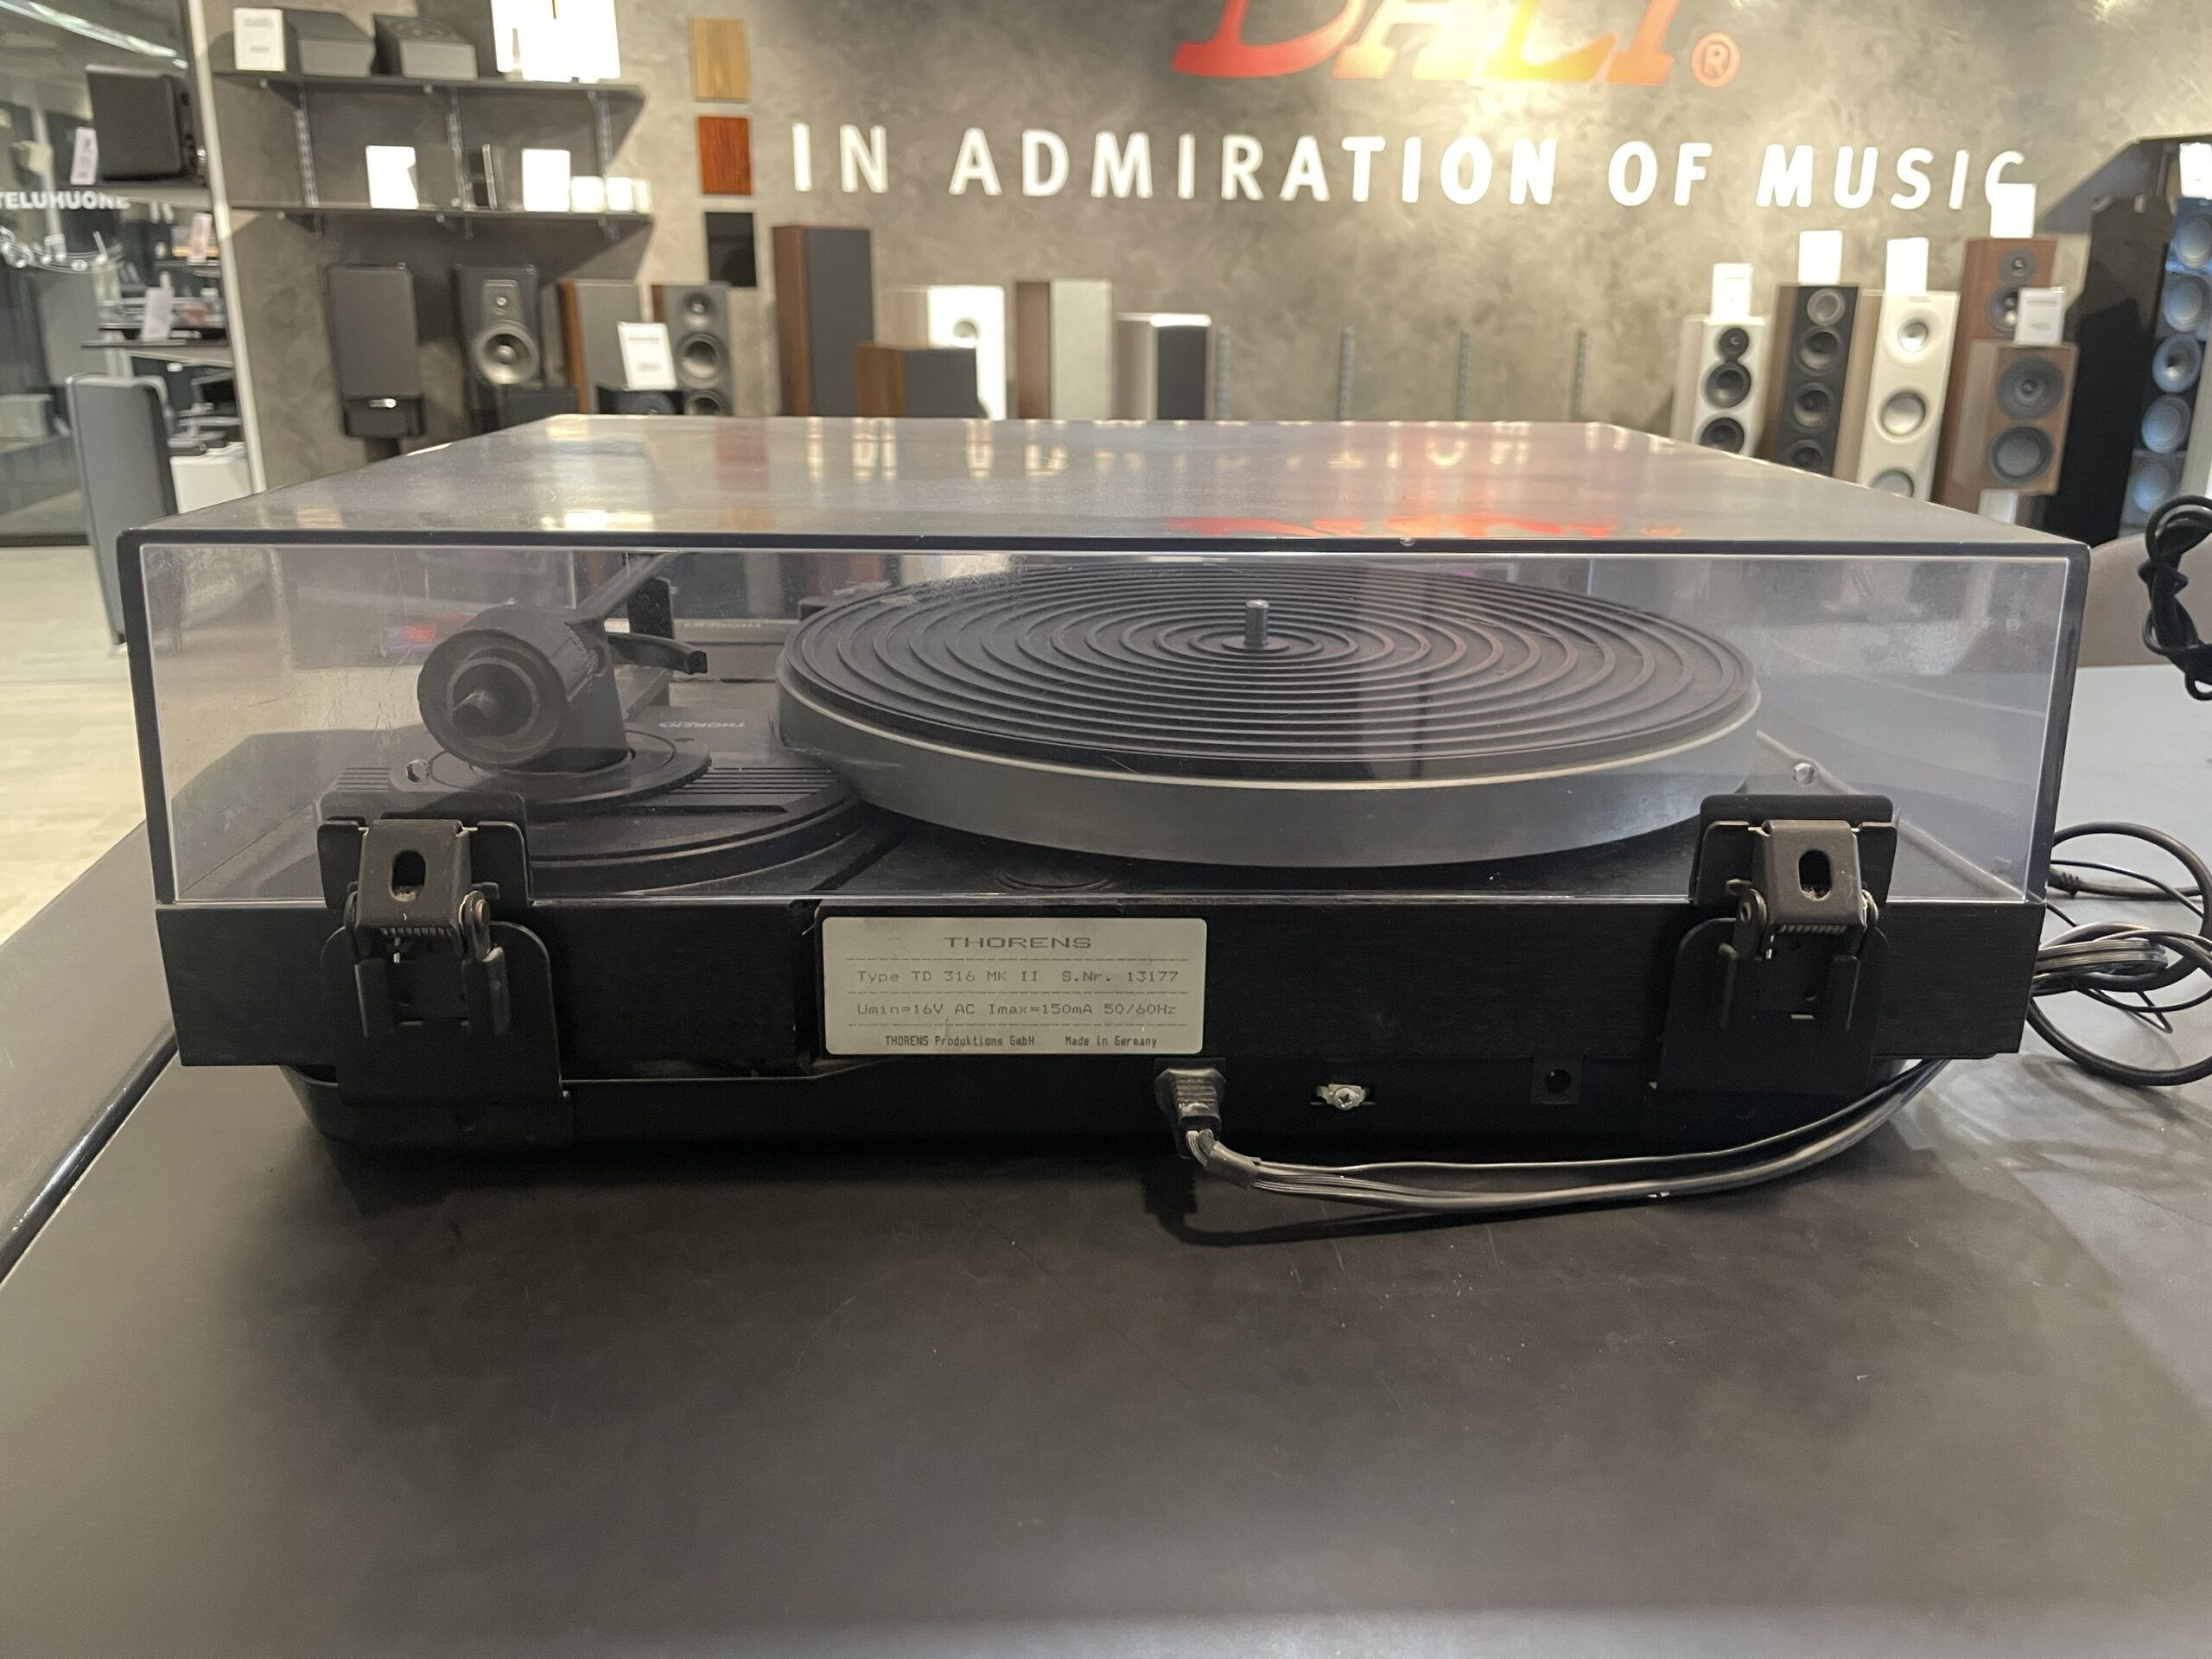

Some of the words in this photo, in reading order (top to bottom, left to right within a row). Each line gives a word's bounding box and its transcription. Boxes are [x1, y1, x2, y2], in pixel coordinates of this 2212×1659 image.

[791, 122, 888, 194] IN
[949, 126, 1557, 206] ADMIRATION
[1608, 141, 1713, 207] OF
[1755, 143, 2025, 210] MUSIC
[944, 937, 1092, 949] THORENS
[857, 970, 899, 983] Type
[912, 970, 932, 982] TD
[944, 970, 976, 982] 316
[987, 970, 1008, 982] MK
[1020, 970, 1038, 982] II
[1062, 970, 1112, 982] S.Nr.
[1127, 970, 1179, 982] 13177
[857, 1003, 944, 1015] Umin=16V
[954, 1003, 976, 1015] AC
[988, 1002, 1093, 1015] Imax=150mA
[1103, 1002, 1177, 1015] 50/60Hz
[885, 1036, 930, 1047] THORENS
[935, 1036, 1003, 1047] Produktions
[1009, 1036, 1035, 1047] GmbH
[1065, 1036, 1090, 1047] Made
[1096, 1036, 1109, 1047] in
[1114, 1036, 1158, 1049] Germany
